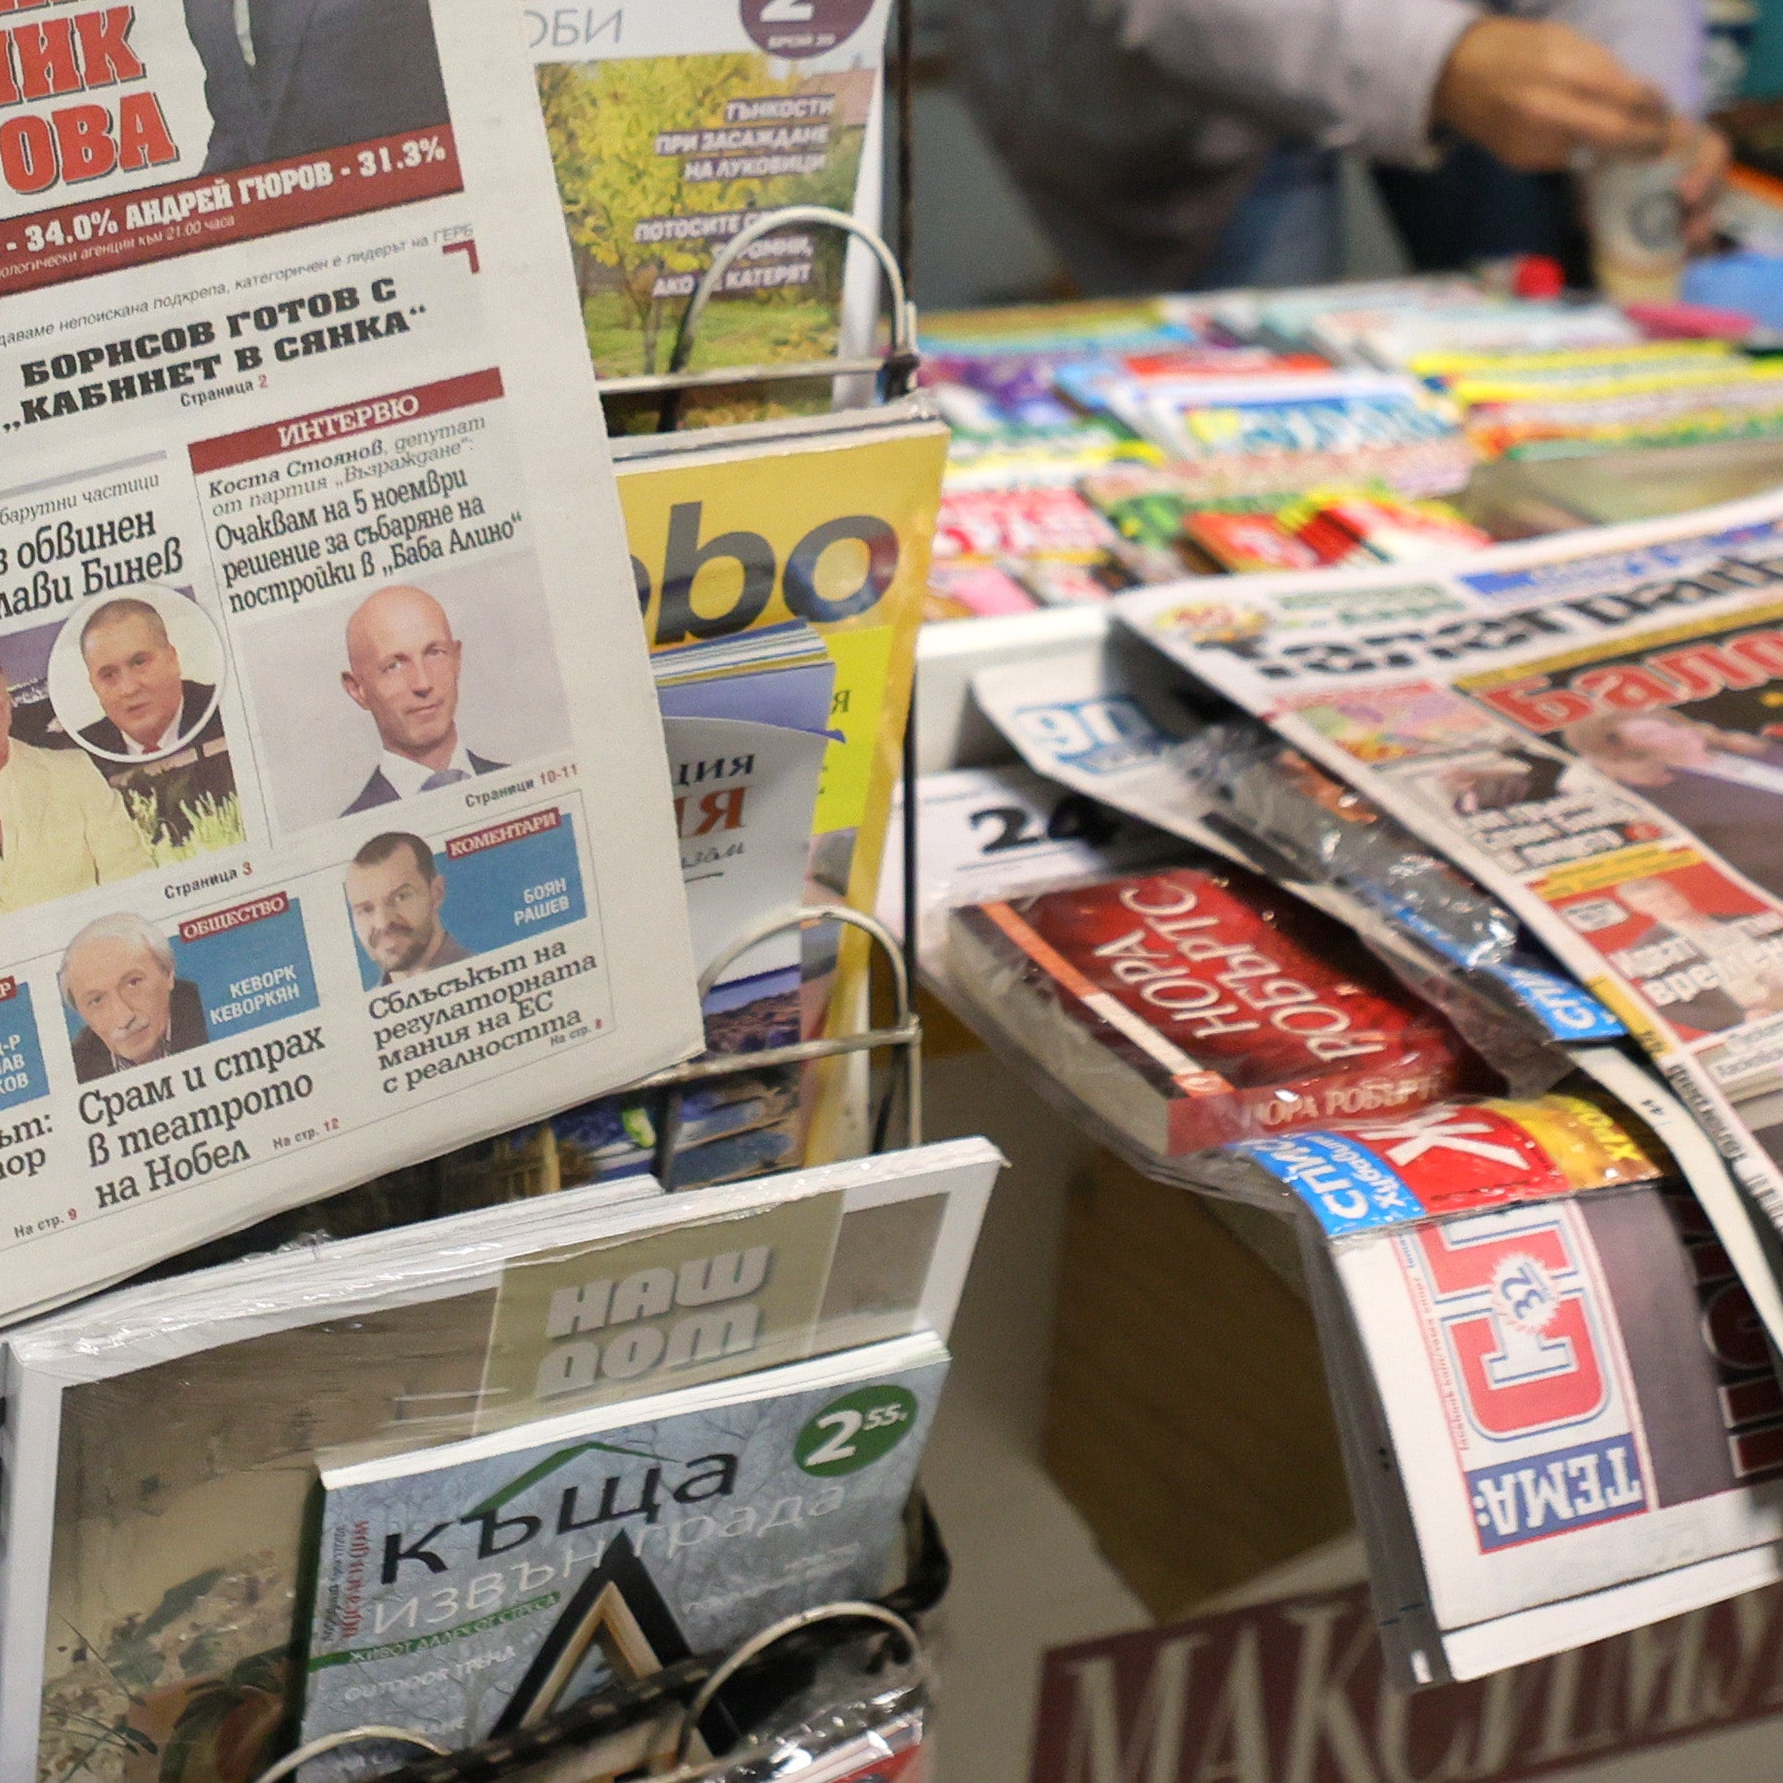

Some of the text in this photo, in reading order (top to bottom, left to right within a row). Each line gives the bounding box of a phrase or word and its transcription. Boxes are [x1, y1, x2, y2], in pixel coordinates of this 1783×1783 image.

[24, 206, 119, 254] 34.0%
[122, 175, 234, 233] АНДРЕЙ
[237, 158, 334, 206] ГЮРОВ
[356, 133, 447, 180] 31.3%
[0, 299, 429, 434] „КАБИНЕТ В СЯНКА“
[19, 273, 397, 393] БОРИСОВ ГОТОВ С
[276, 388, 421, 452] ИНТЕРВЮ
[12, 496, 157, 574] обвинен
[76, 533, 185, 600] Бинев
[448, 806, 559, 863] КОМЕНТАРИ
[181, 891, 286, 946] ОБЩЕСТВО
[1093, 930, 1261, 1039] НОРА
[1119, 884, 1387, 1061] РОБЪРТС
[545, 1243, 774, 1340] НАШ
[379, 1451, 740, 1586] къща
[1475, 1444, 1643, 1537] ТЕМА:
[373, 1528, 603, 1635] извън
